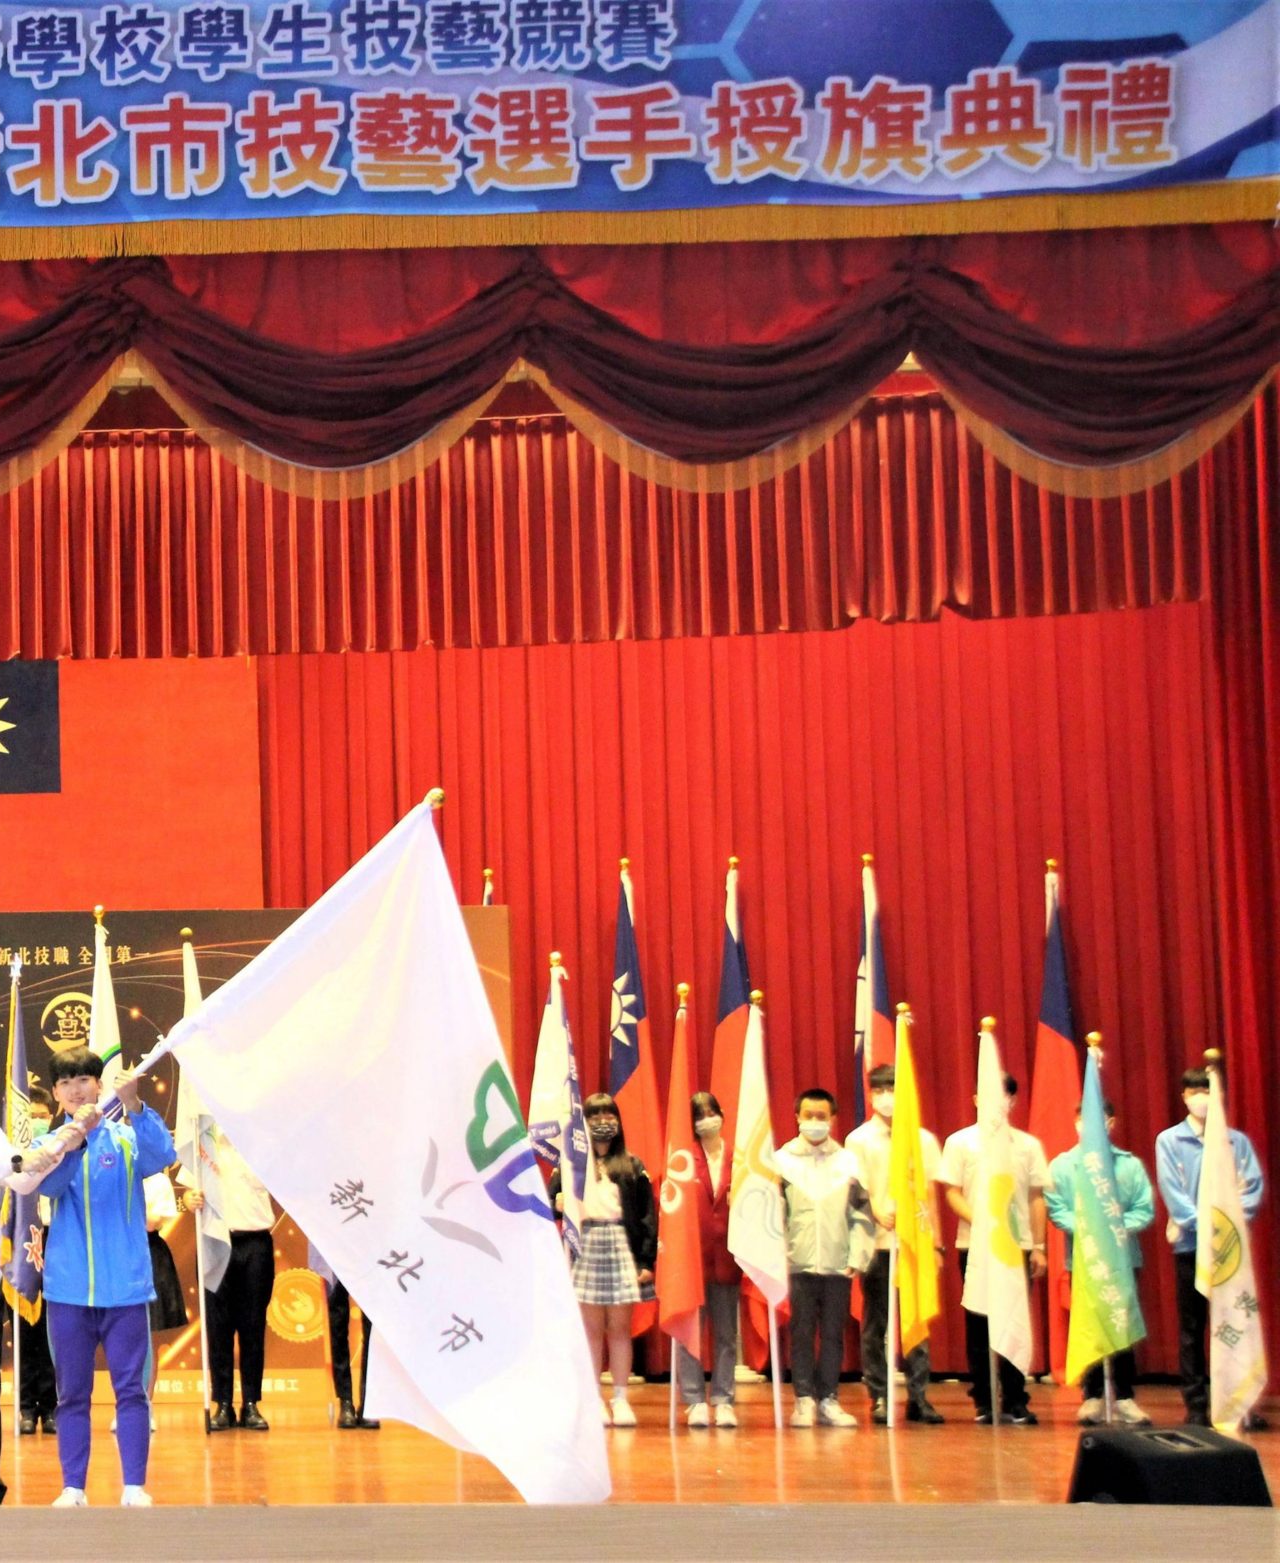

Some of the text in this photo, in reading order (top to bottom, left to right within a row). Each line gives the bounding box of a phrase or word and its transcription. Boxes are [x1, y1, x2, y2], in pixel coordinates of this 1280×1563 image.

[78, 945, 150, 966] 全第一
[329, 1178, 484, 1353] 新北市
